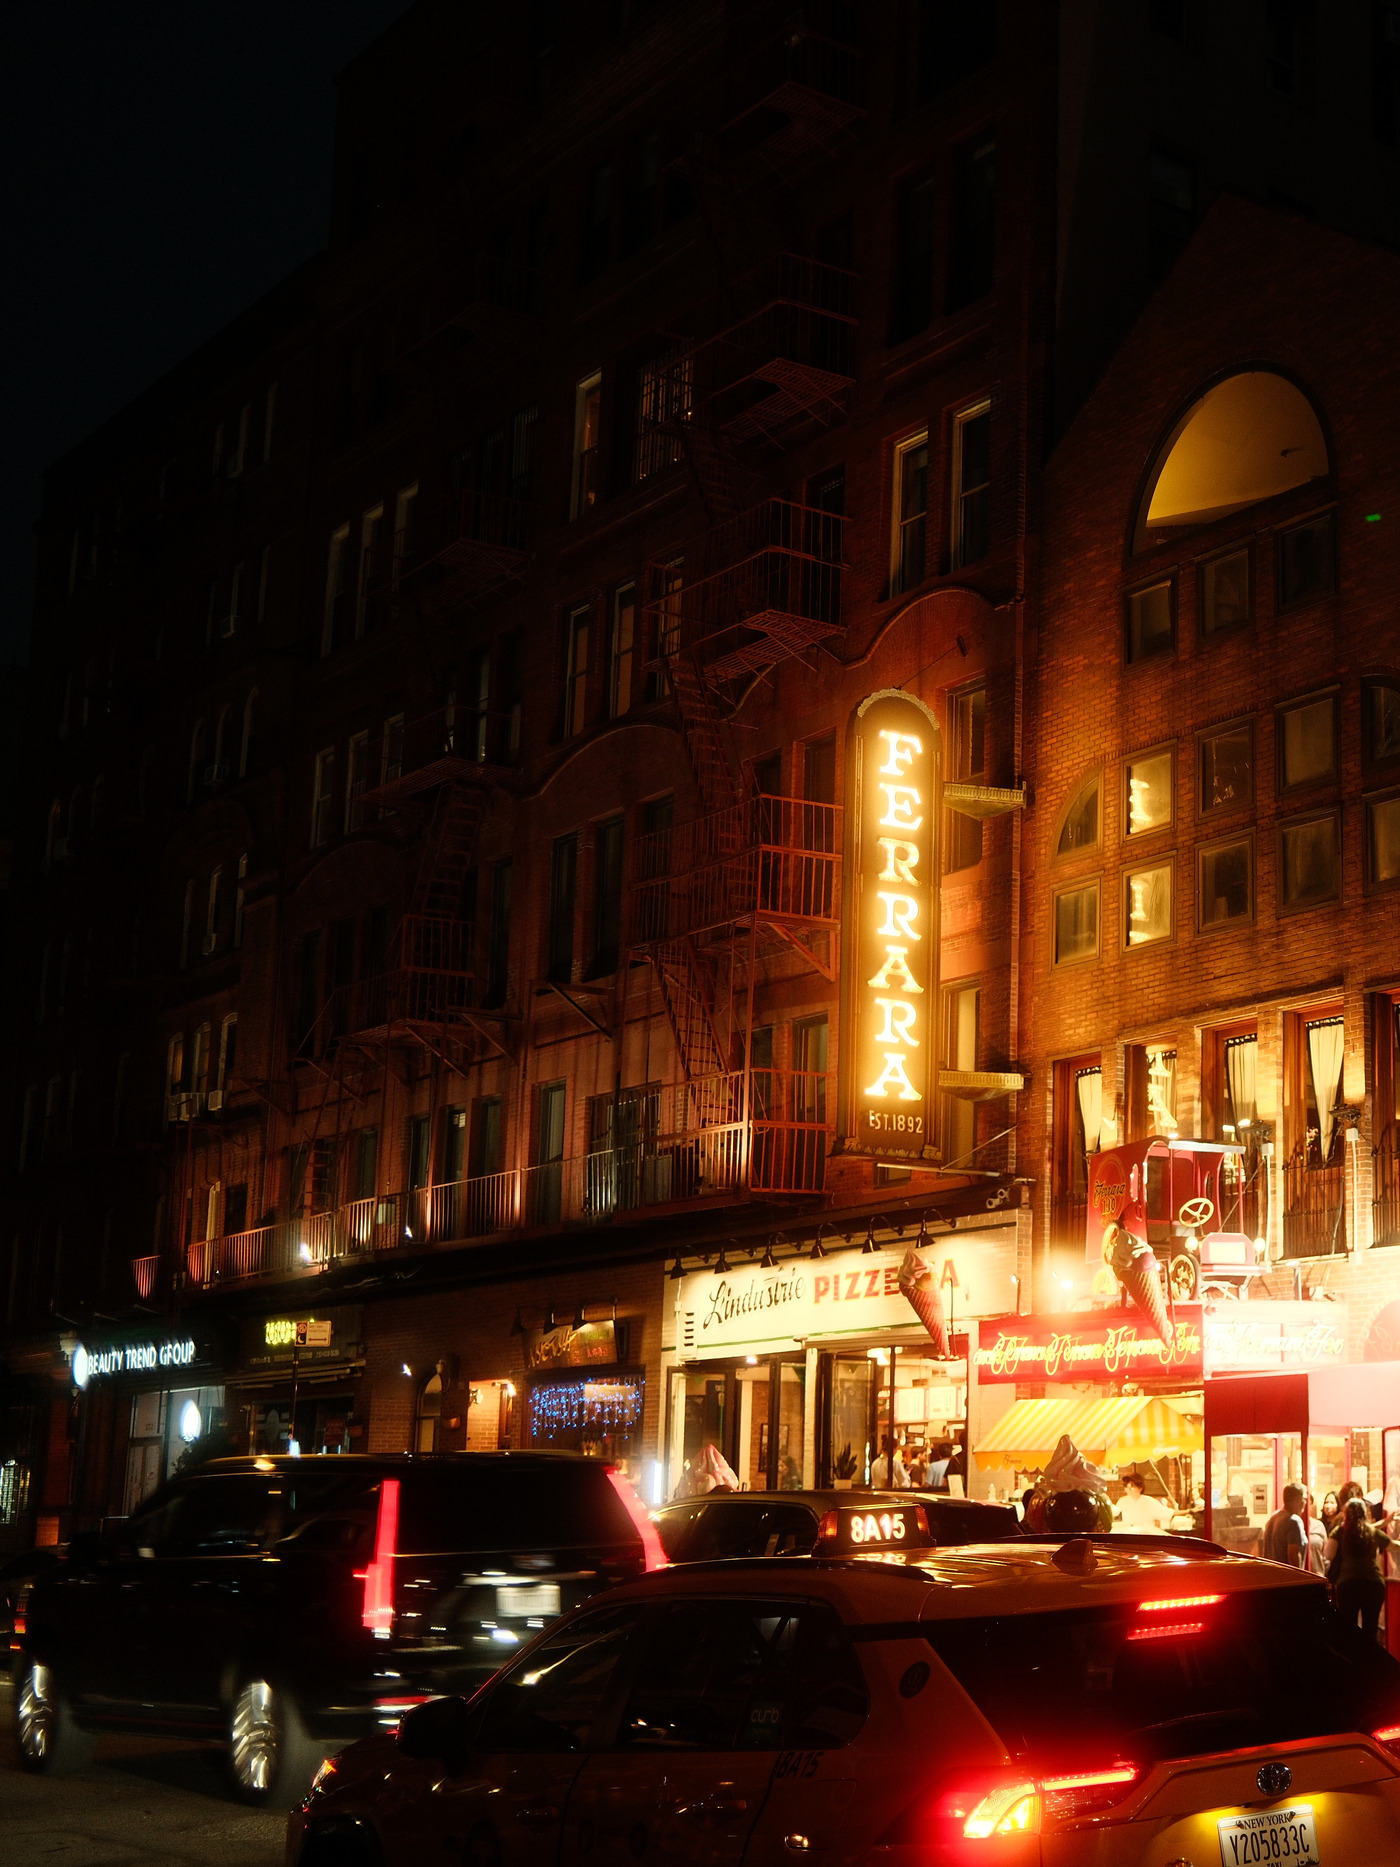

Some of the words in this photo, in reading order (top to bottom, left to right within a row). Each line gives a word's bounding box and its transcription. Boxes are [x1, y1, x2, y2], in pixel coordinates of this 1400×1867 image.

[864, 728, 925, 1101] FERRARA
[813, 1258, 961, 1304] PIZZEA
[88, 1350, 124, 1375] BEAUTY
[125, 1345, 158, 1369] TREND
[851, 1513, 906, 1543] 8A15
[1243, 1816, 1266, 1830] NEW
[1266, 1813, 1291, 1827] YORK
[1229, 1823, 1311, 1866] Y205833C
